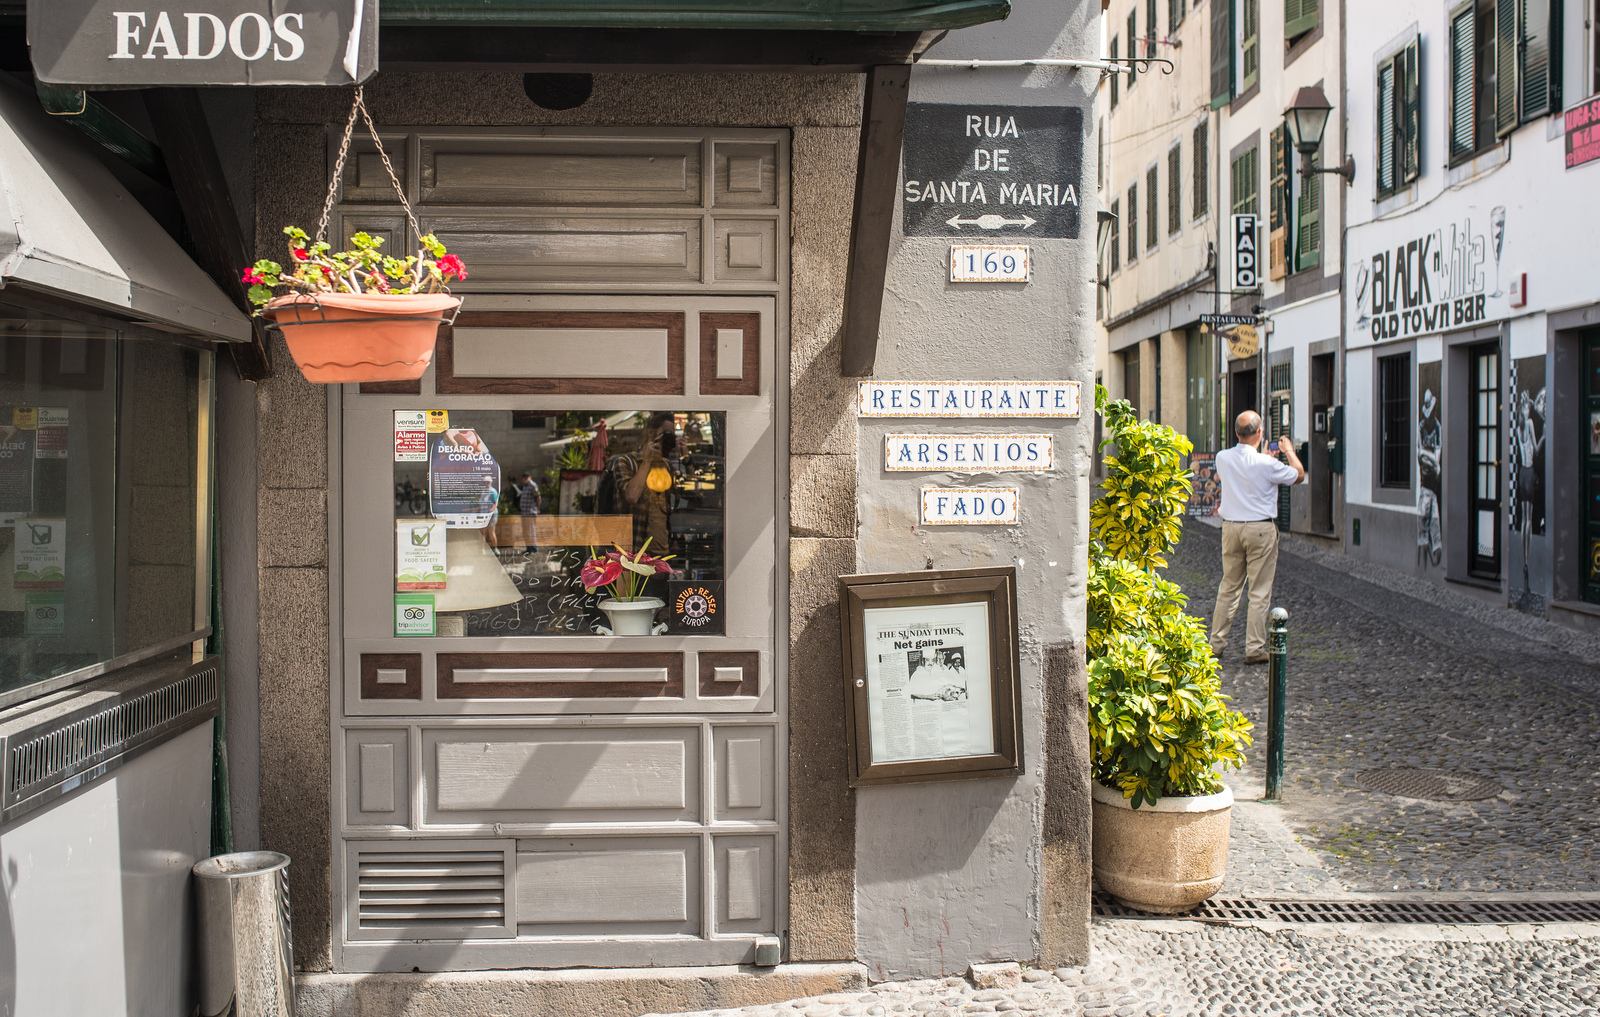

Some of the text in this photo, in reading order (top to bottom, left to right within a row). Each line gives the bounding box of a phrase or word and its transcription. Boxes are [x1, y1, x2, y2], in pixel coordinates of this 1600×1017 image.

[111, 11, 305, 62] FADOS
[966, 115, 1018, 138] RUA
[974, 149, 1009, 171] DE
[905, 181, 1078, 206] SANTA MARIA
[1237, 217, 1254, 286] FADO
[966, 252, 1016, 274] 169
[1372, 234, 1432, 315] BLACK
[1436, 217, 1485, 302] White
[1201, 315, 1255, 324] RESTAURANTE
[1372, 314, 1399, 342] OLD
[873, 389, 1067, 409] RESTAURANTE
[438, 445, 474, 453] DESAFIO
[449, 453, 491, 463] CORAÇÃO
[899, 443, 1039, 463] ARSENIOS
[937, 497, 1006, 516] FADO
[675, 587, 717, 614] KULTUR REJSER
[681, 615, 711, 627] EUROPA
[878, 627, 961, 639] THE SUNDAY TIMES
[894, 638, 944, 650] Net gains
